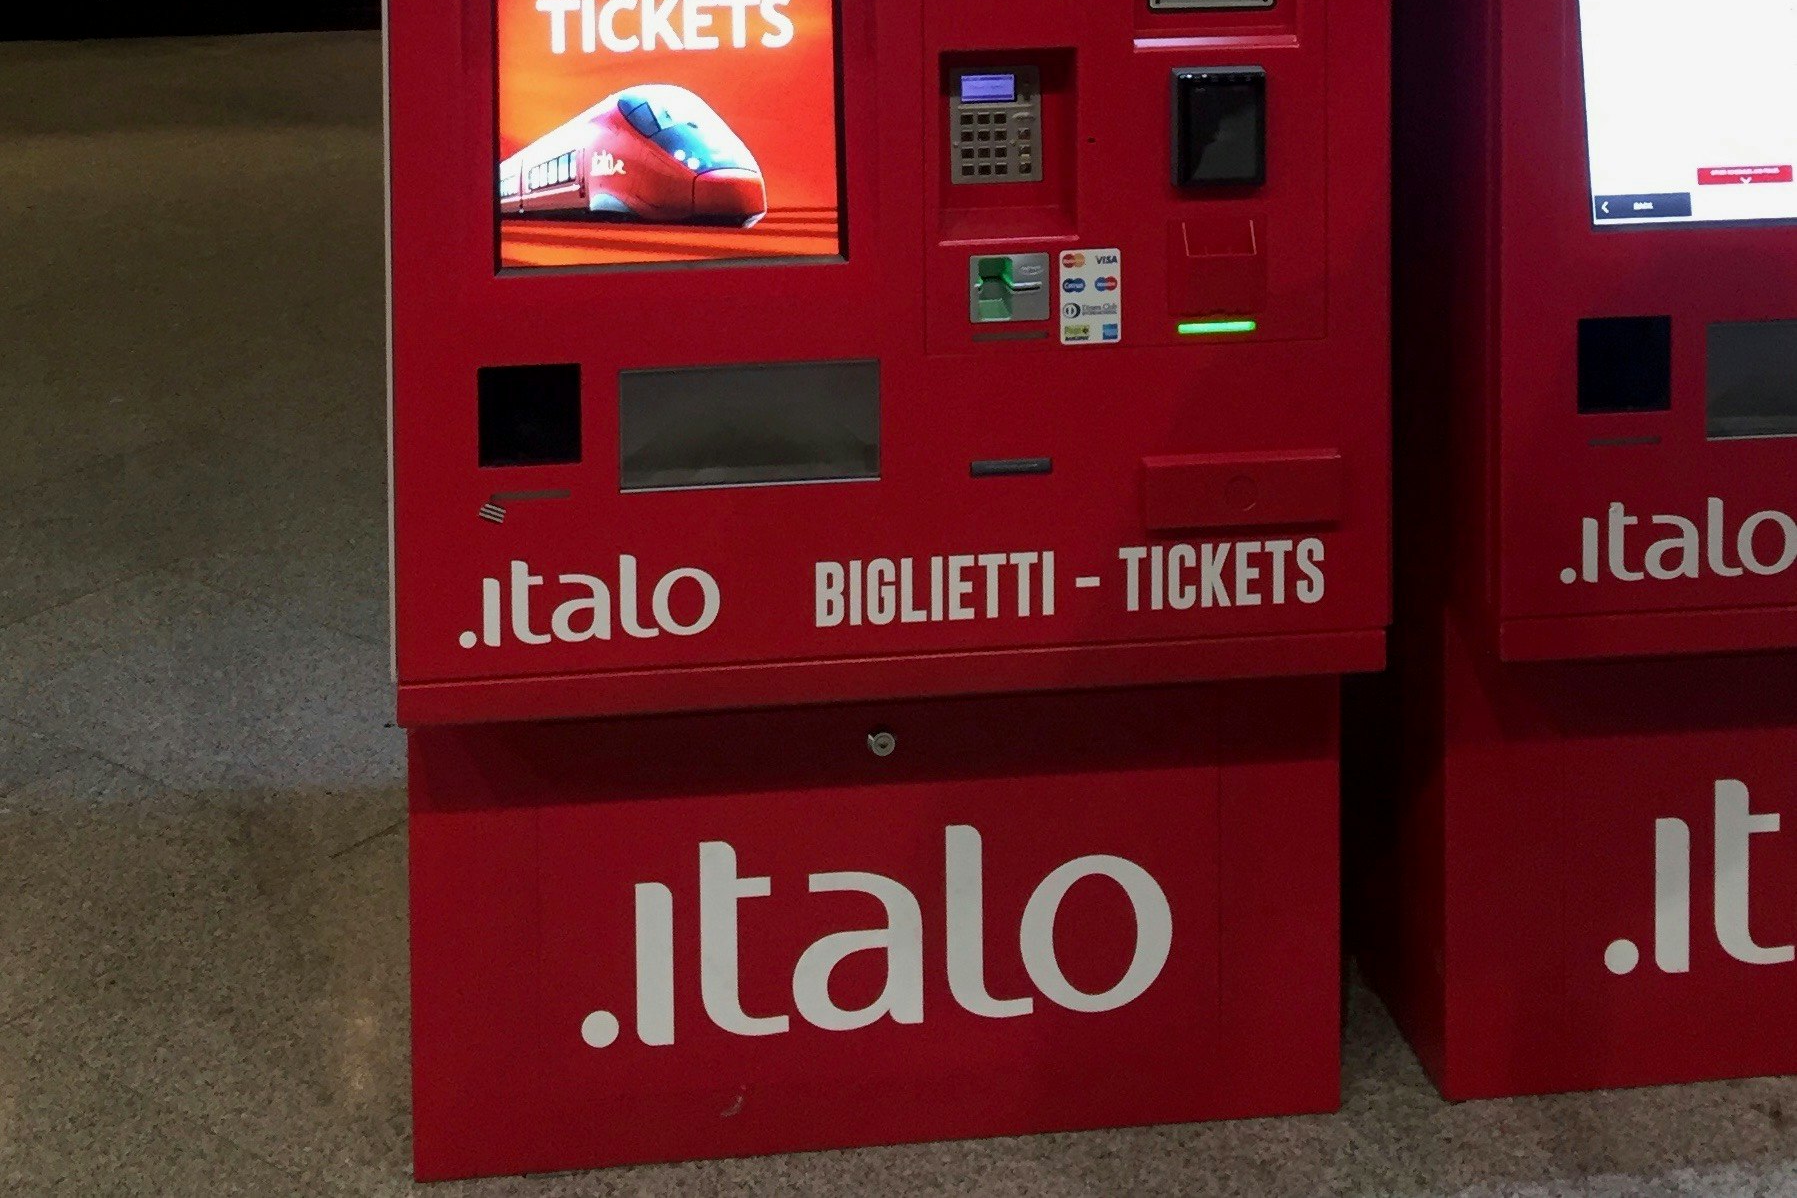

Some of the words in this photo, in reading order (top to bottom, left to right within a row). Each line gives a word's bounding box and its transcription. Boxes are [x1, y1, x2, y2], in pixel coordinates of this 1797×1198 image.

[1095, 255, 1118, 264] VISA
[815, 550, 1055, 628] BIGLIETTI
[1118, 537, 1325, 612] TICKETS
